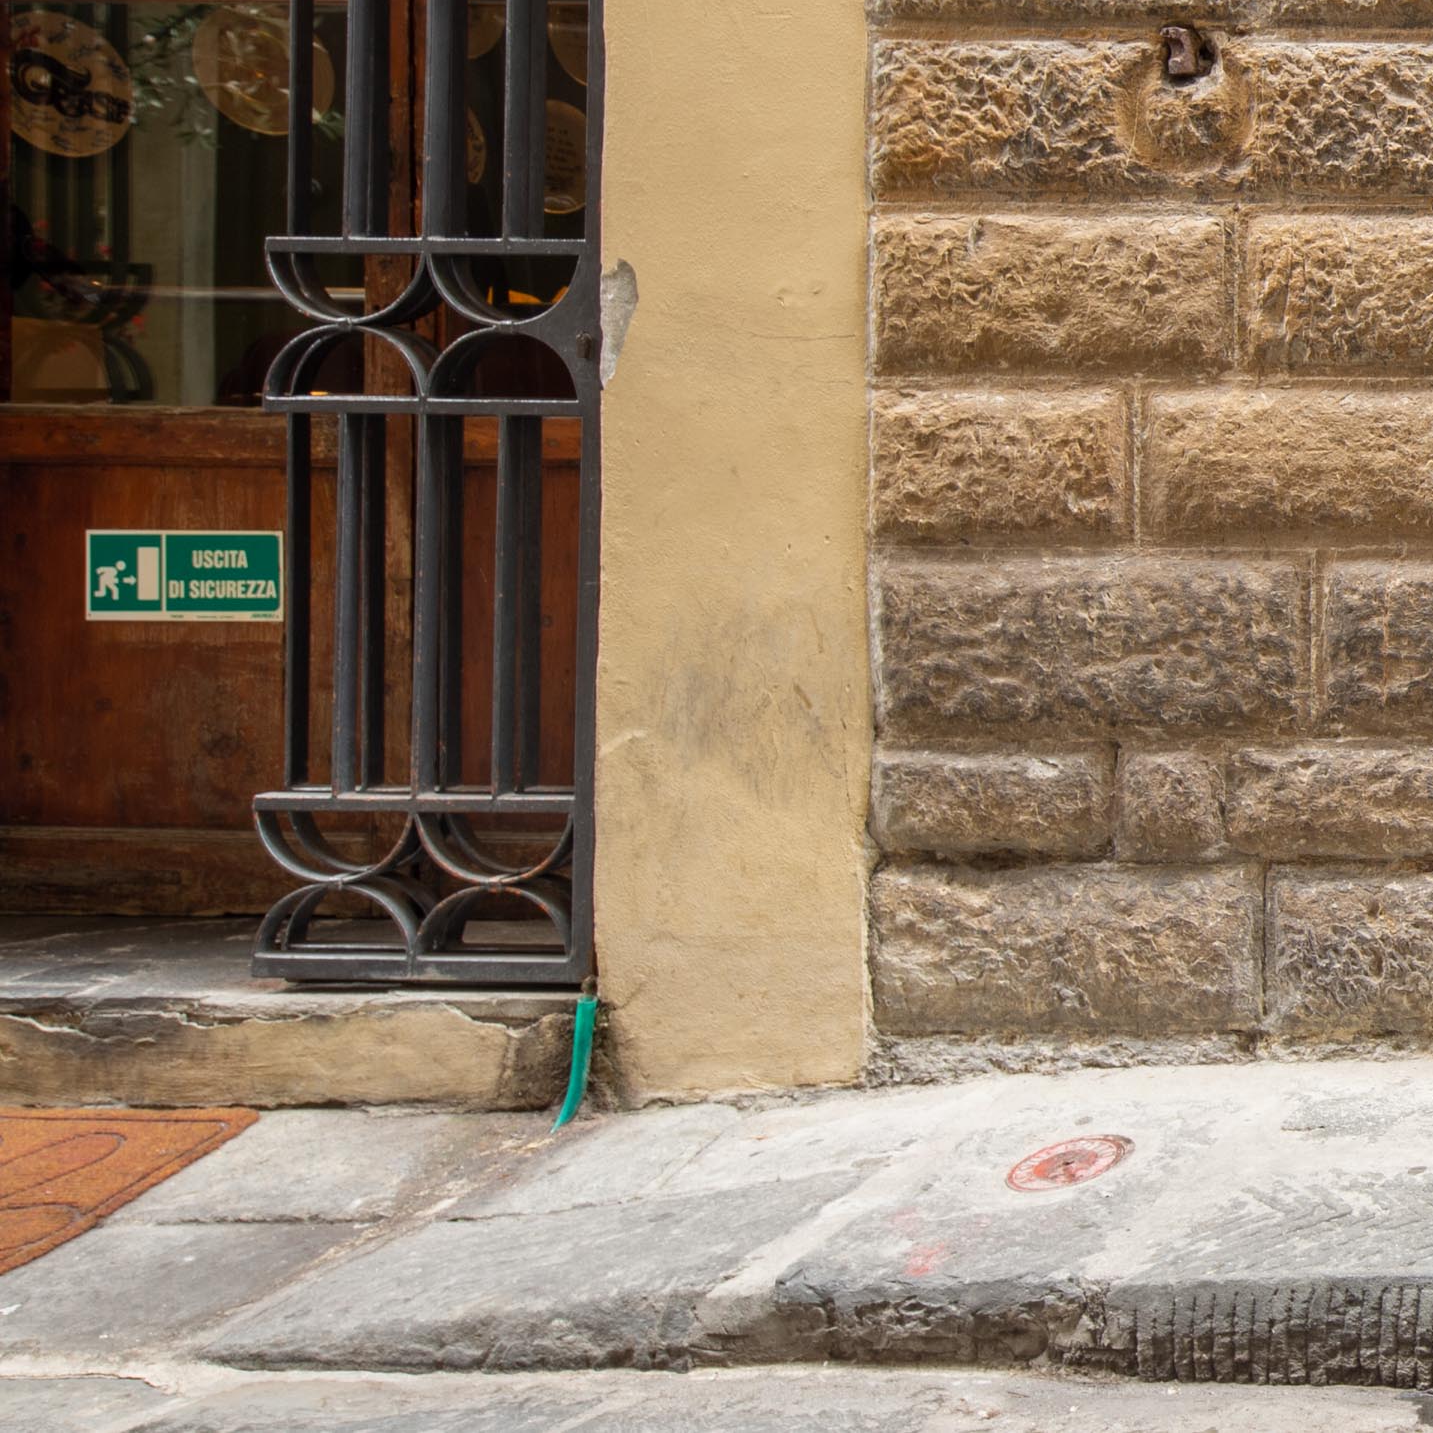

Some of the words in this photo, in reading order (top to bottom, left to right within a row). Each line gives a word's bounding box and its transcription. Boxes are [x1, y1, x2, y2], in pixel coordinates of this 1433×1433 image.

[191, 549, 248, 569] USCITA
[168, 579, 185, 600] DI
[188, 579, 277, 599] SICUREZZA
